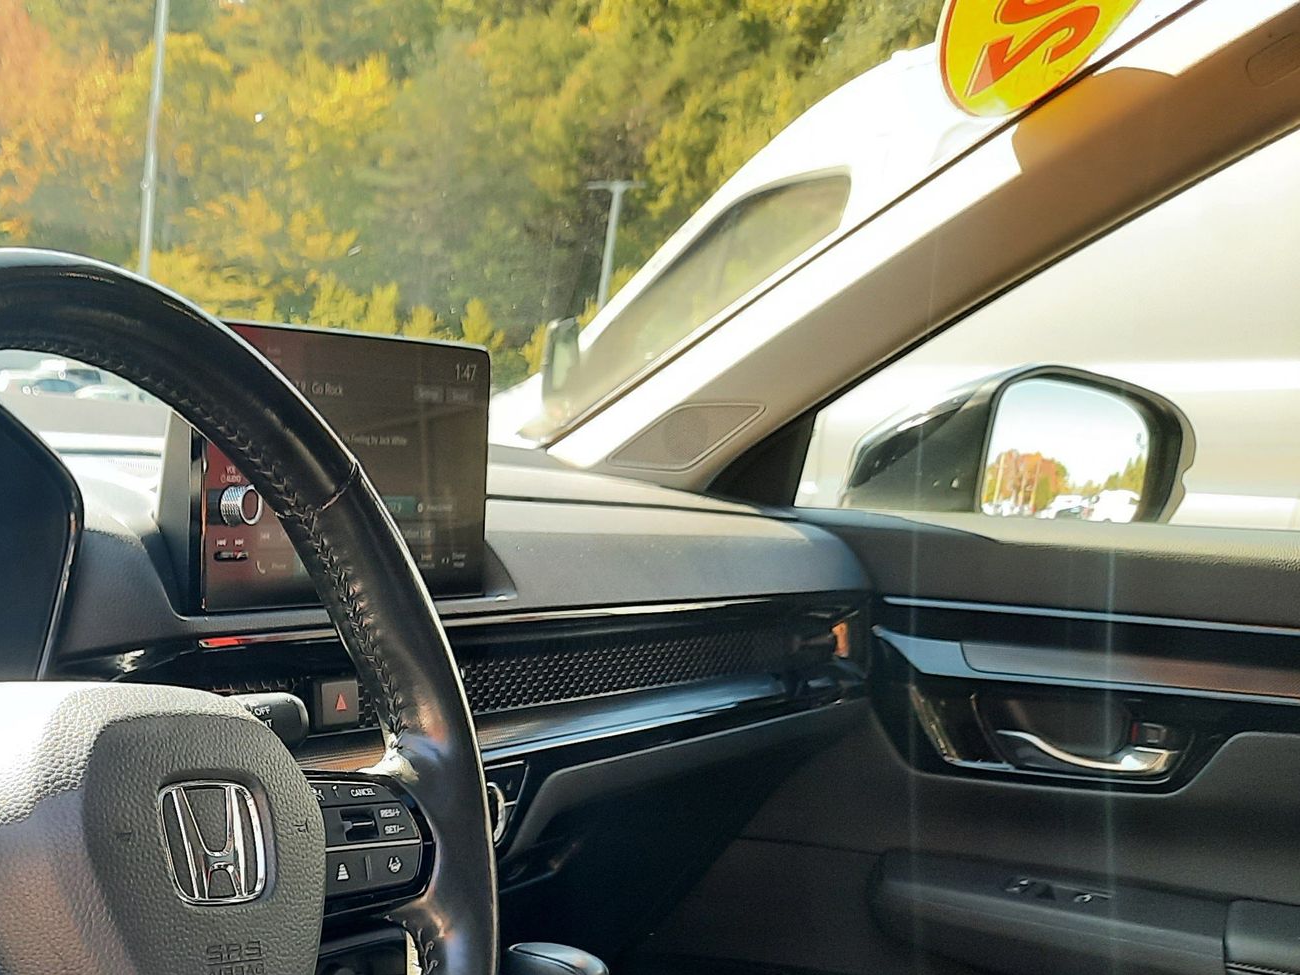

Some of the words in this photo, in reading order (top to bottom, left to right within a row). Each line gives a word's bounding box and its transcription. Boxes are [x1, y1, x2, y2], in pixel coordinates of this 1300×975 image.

[455, 363, 477, 382] 1:47
[254, 706, 271, 716] OFF
[350, 786, 376, 797] CANCEL
[205, 941, 263, 961] SRS
